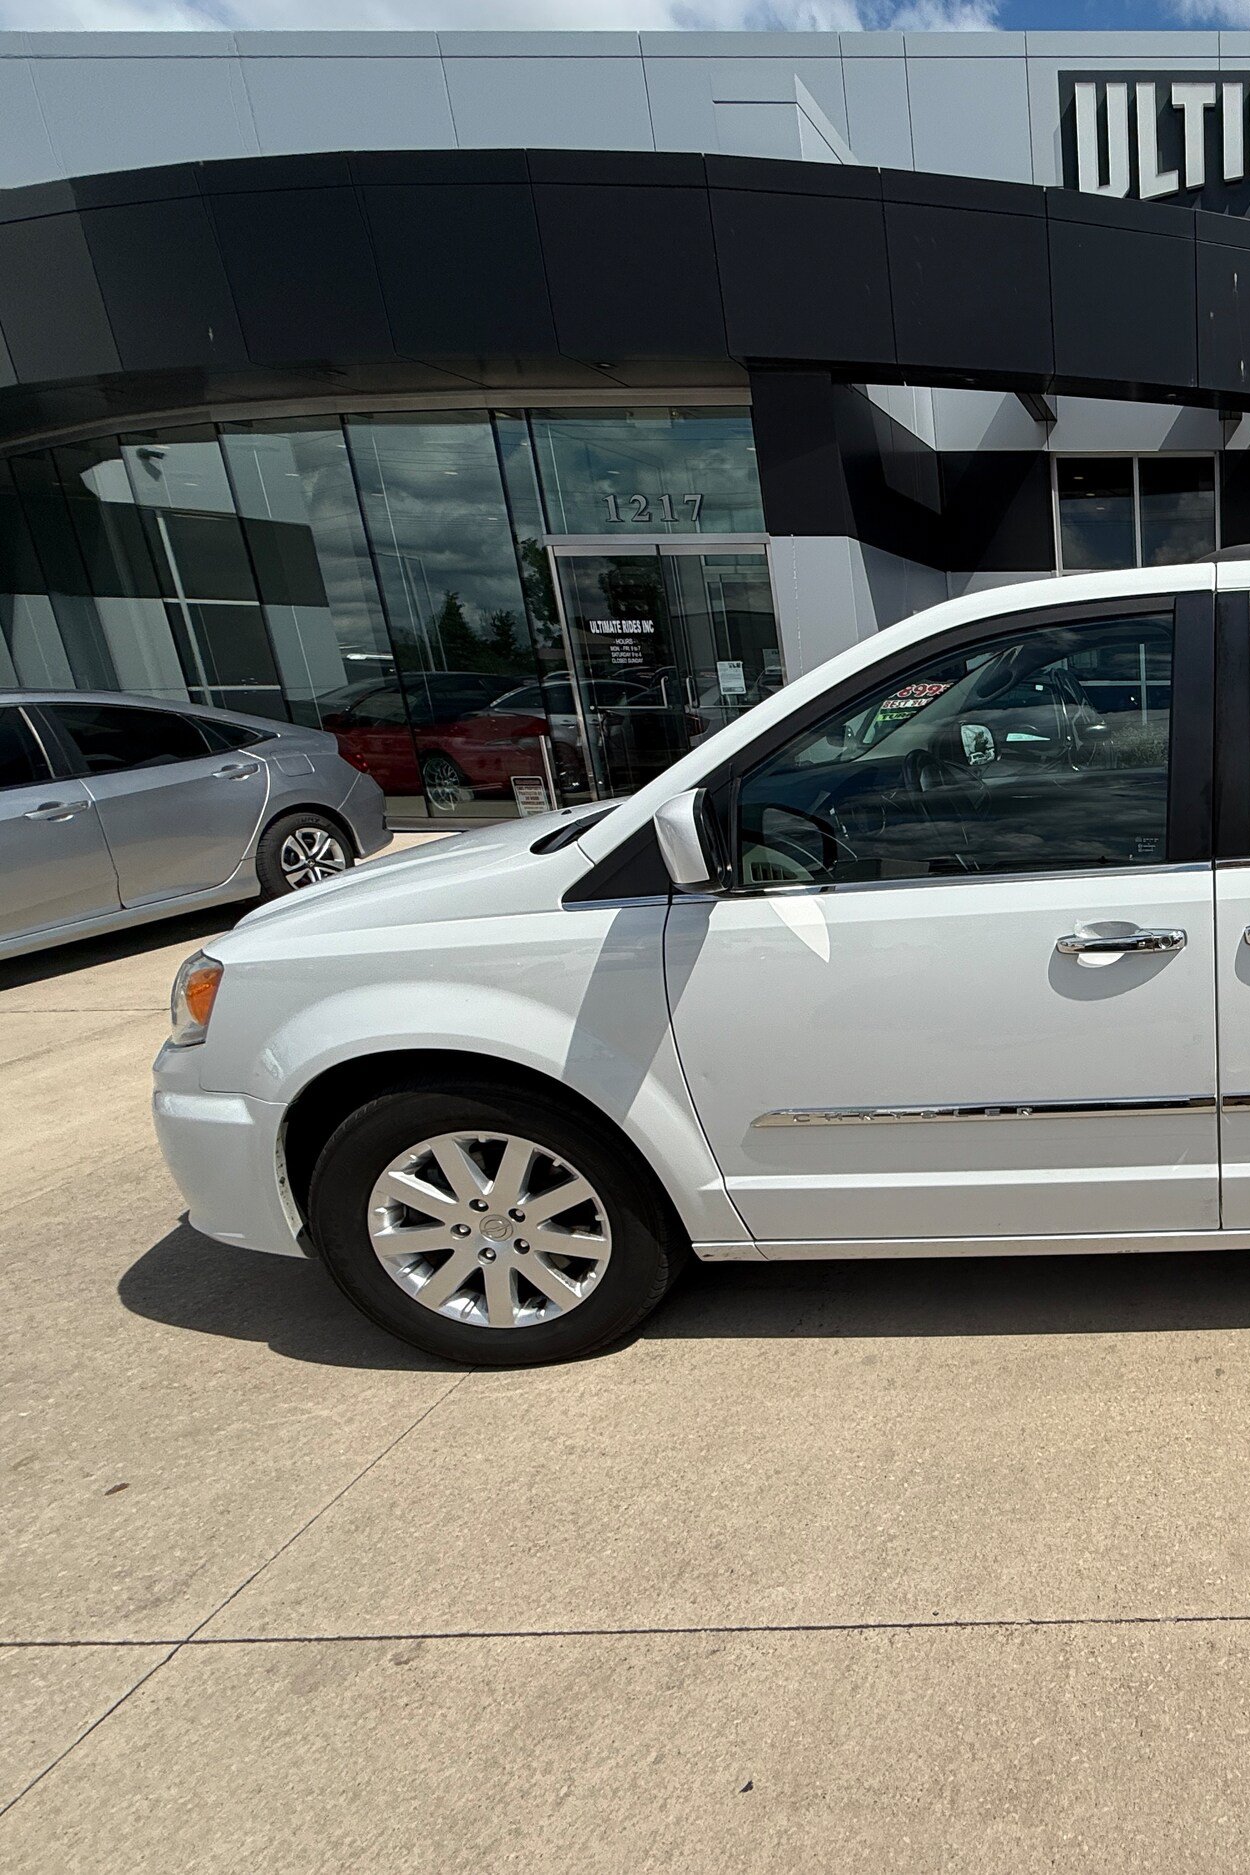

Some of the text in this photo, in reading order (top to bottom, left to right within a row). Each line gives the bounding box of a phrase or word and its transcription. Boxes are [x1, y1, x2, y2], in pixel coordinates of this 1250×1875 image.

[603, 494, 702, 522] 1217
[589, 620, 655, 634] ULTIMATE RIDES INC
[882, 700, 908, 709] BEST
